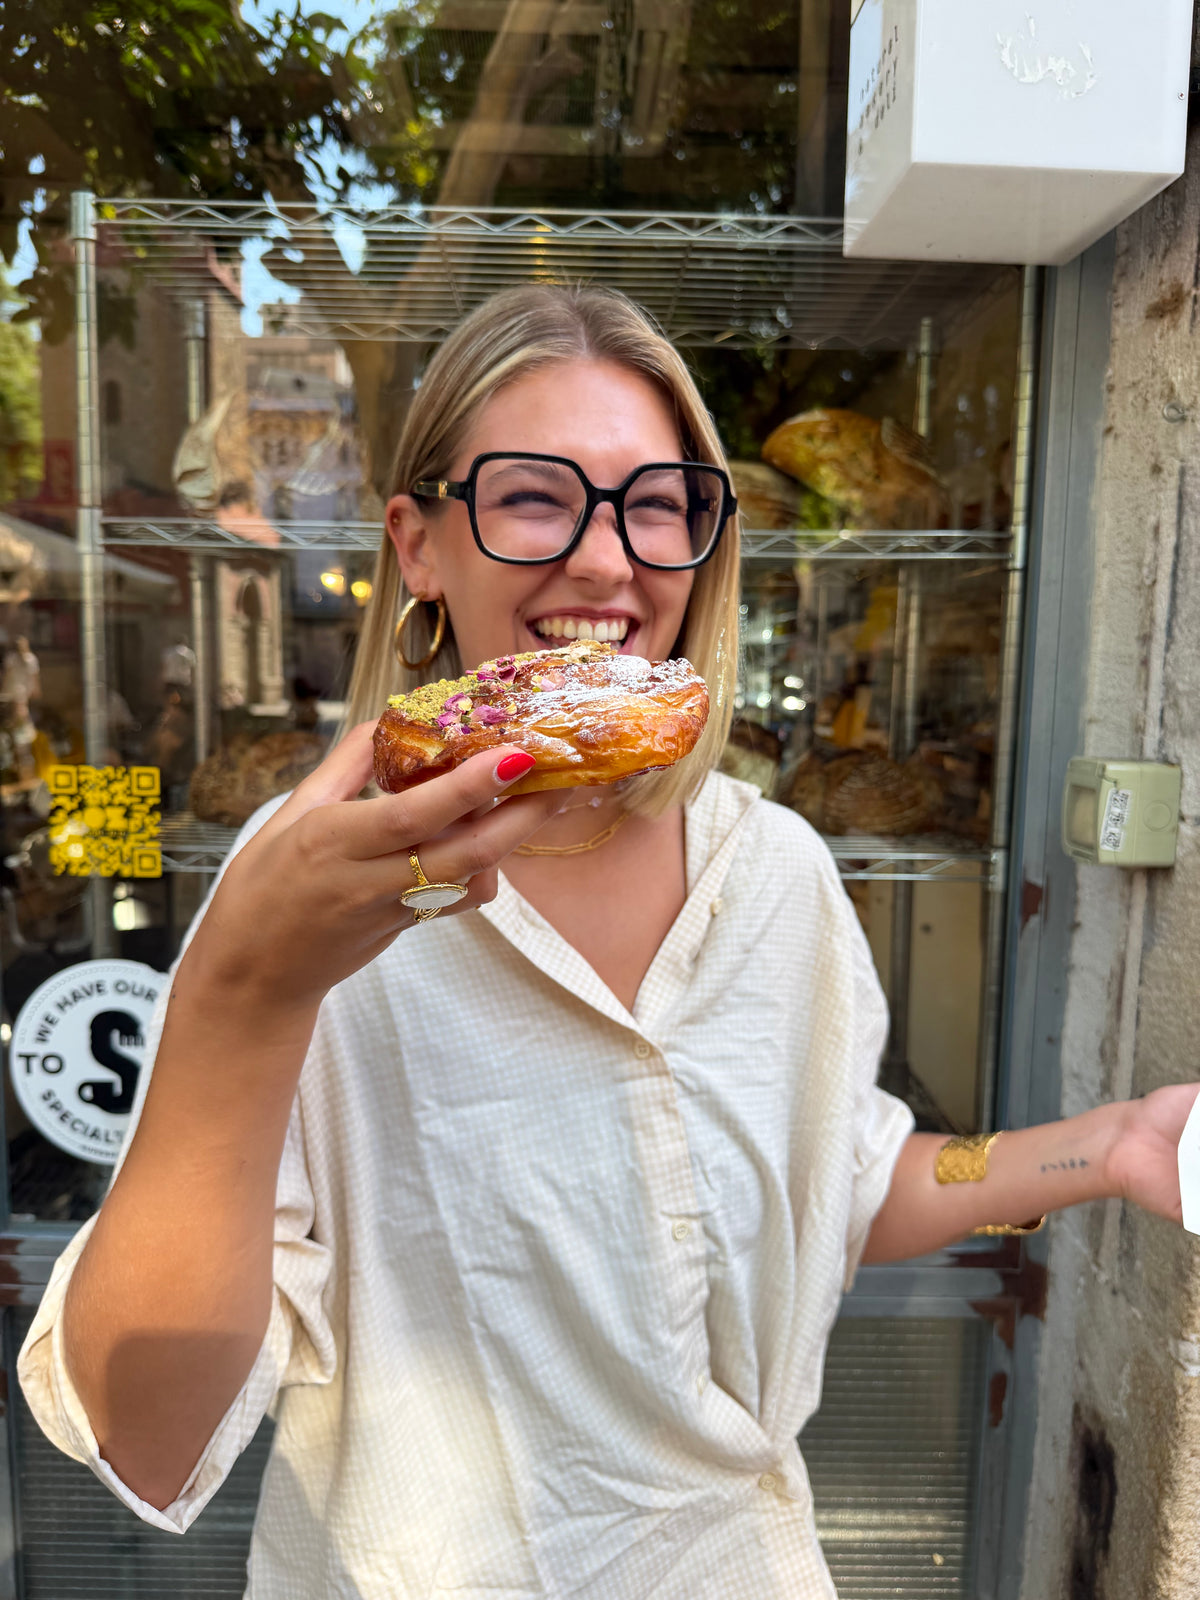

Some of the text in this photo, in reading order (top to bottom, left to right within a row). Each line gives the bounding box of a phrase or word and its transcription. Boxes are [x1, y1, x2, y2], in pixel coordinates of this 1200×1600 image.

[35, 979, 158, 1043] WE HAVE OUR
[18, 1053, 64, 1074] TO
